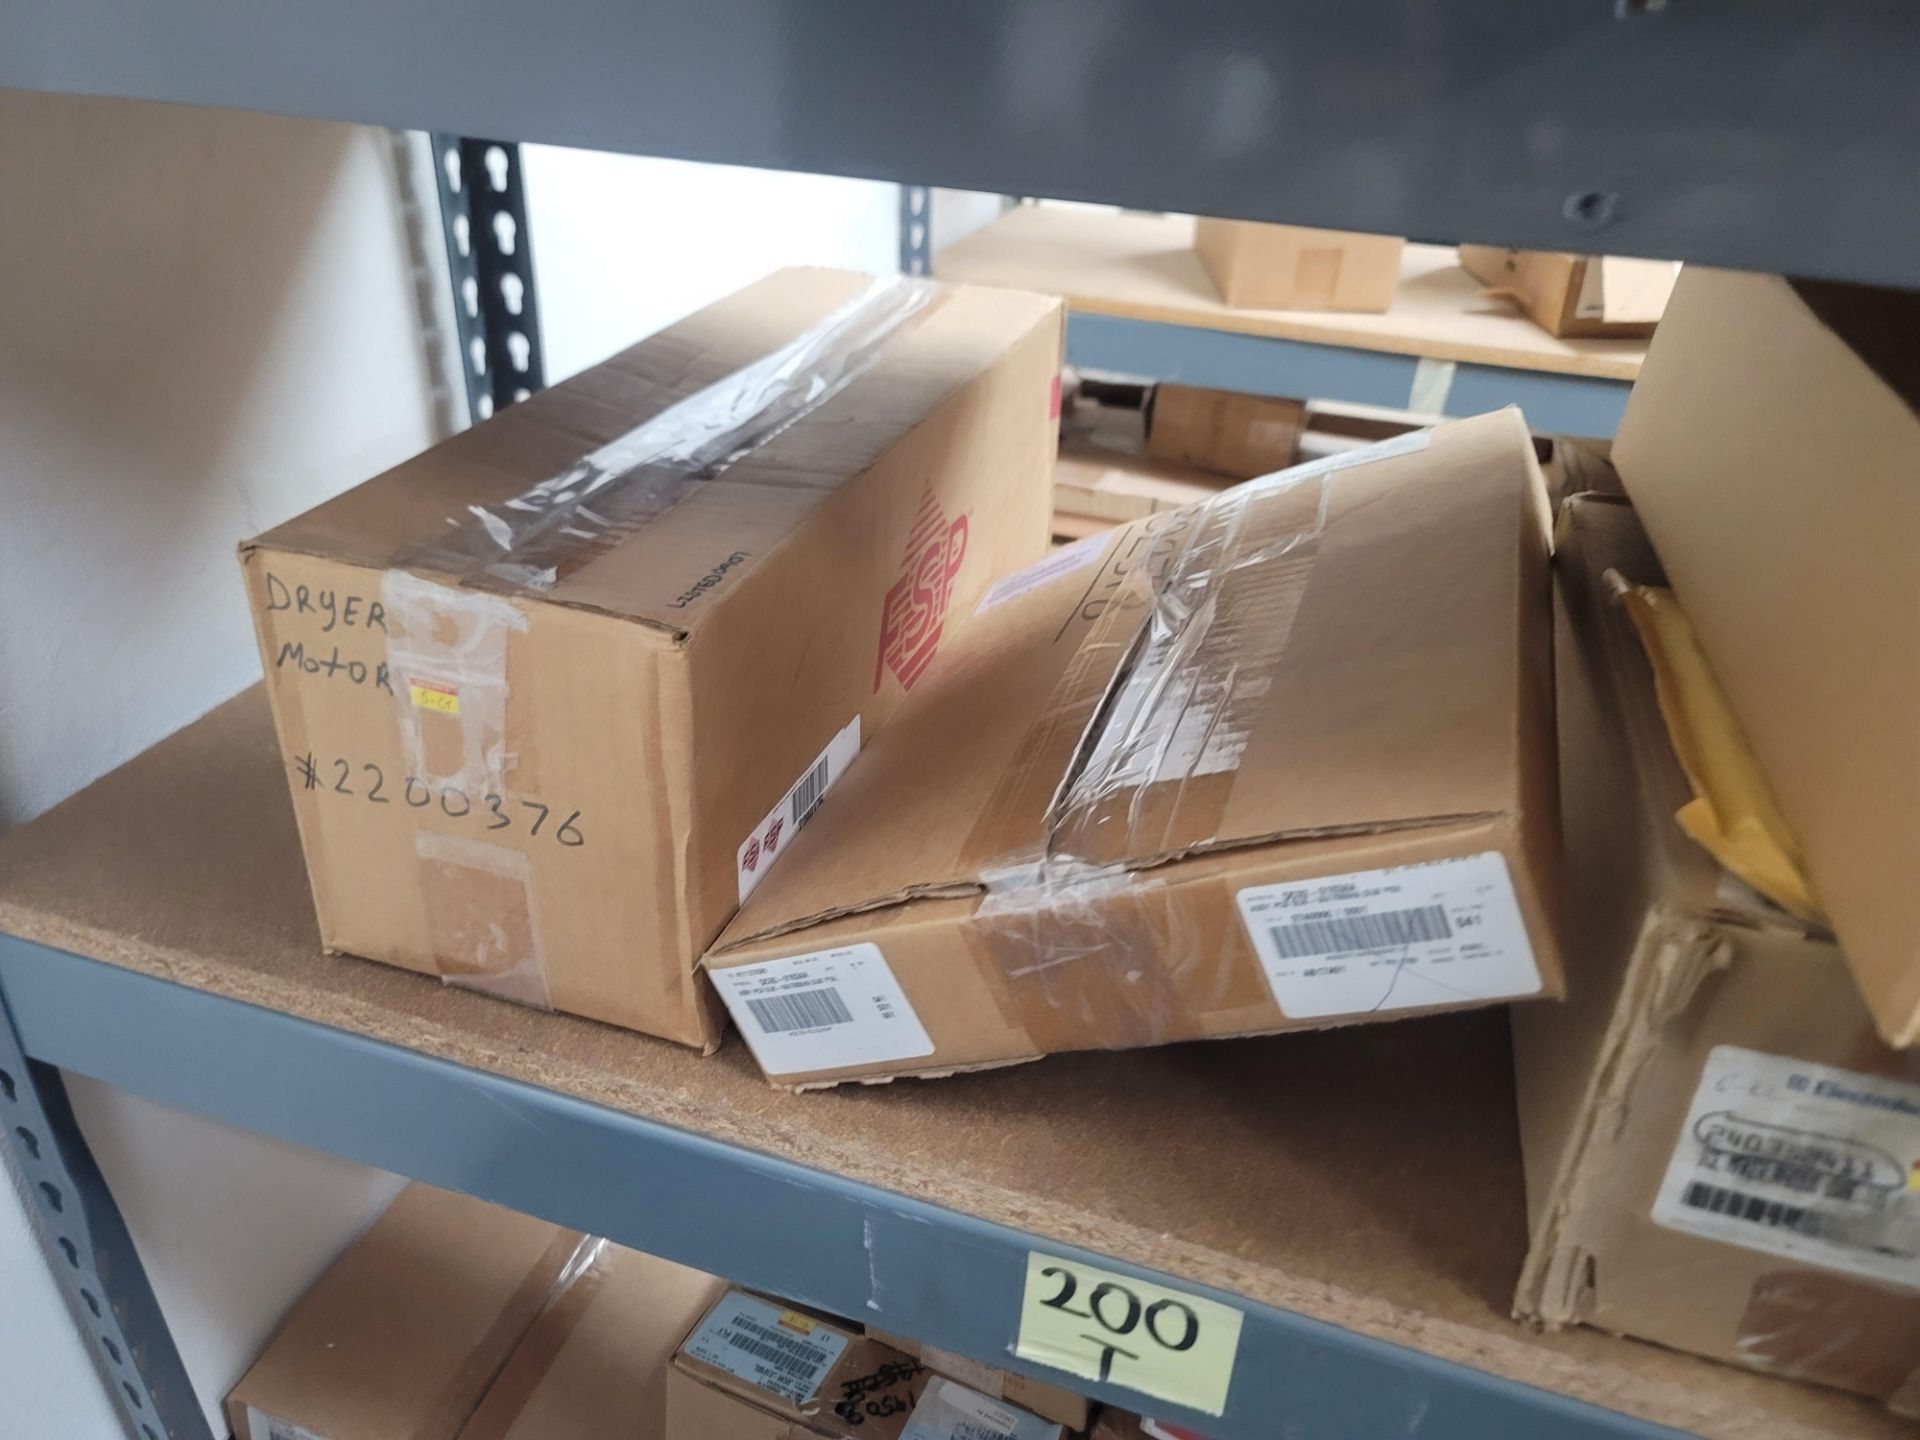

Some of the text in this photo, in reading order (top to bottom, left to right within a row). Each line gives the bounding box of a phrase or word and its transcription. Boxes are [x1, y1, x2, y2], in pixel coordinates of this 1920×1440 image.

[266, 572, 388, 633] DRYER
[294, 752, 585, 847] #2200376
[1040, 1266, 1200, 1352] 200
